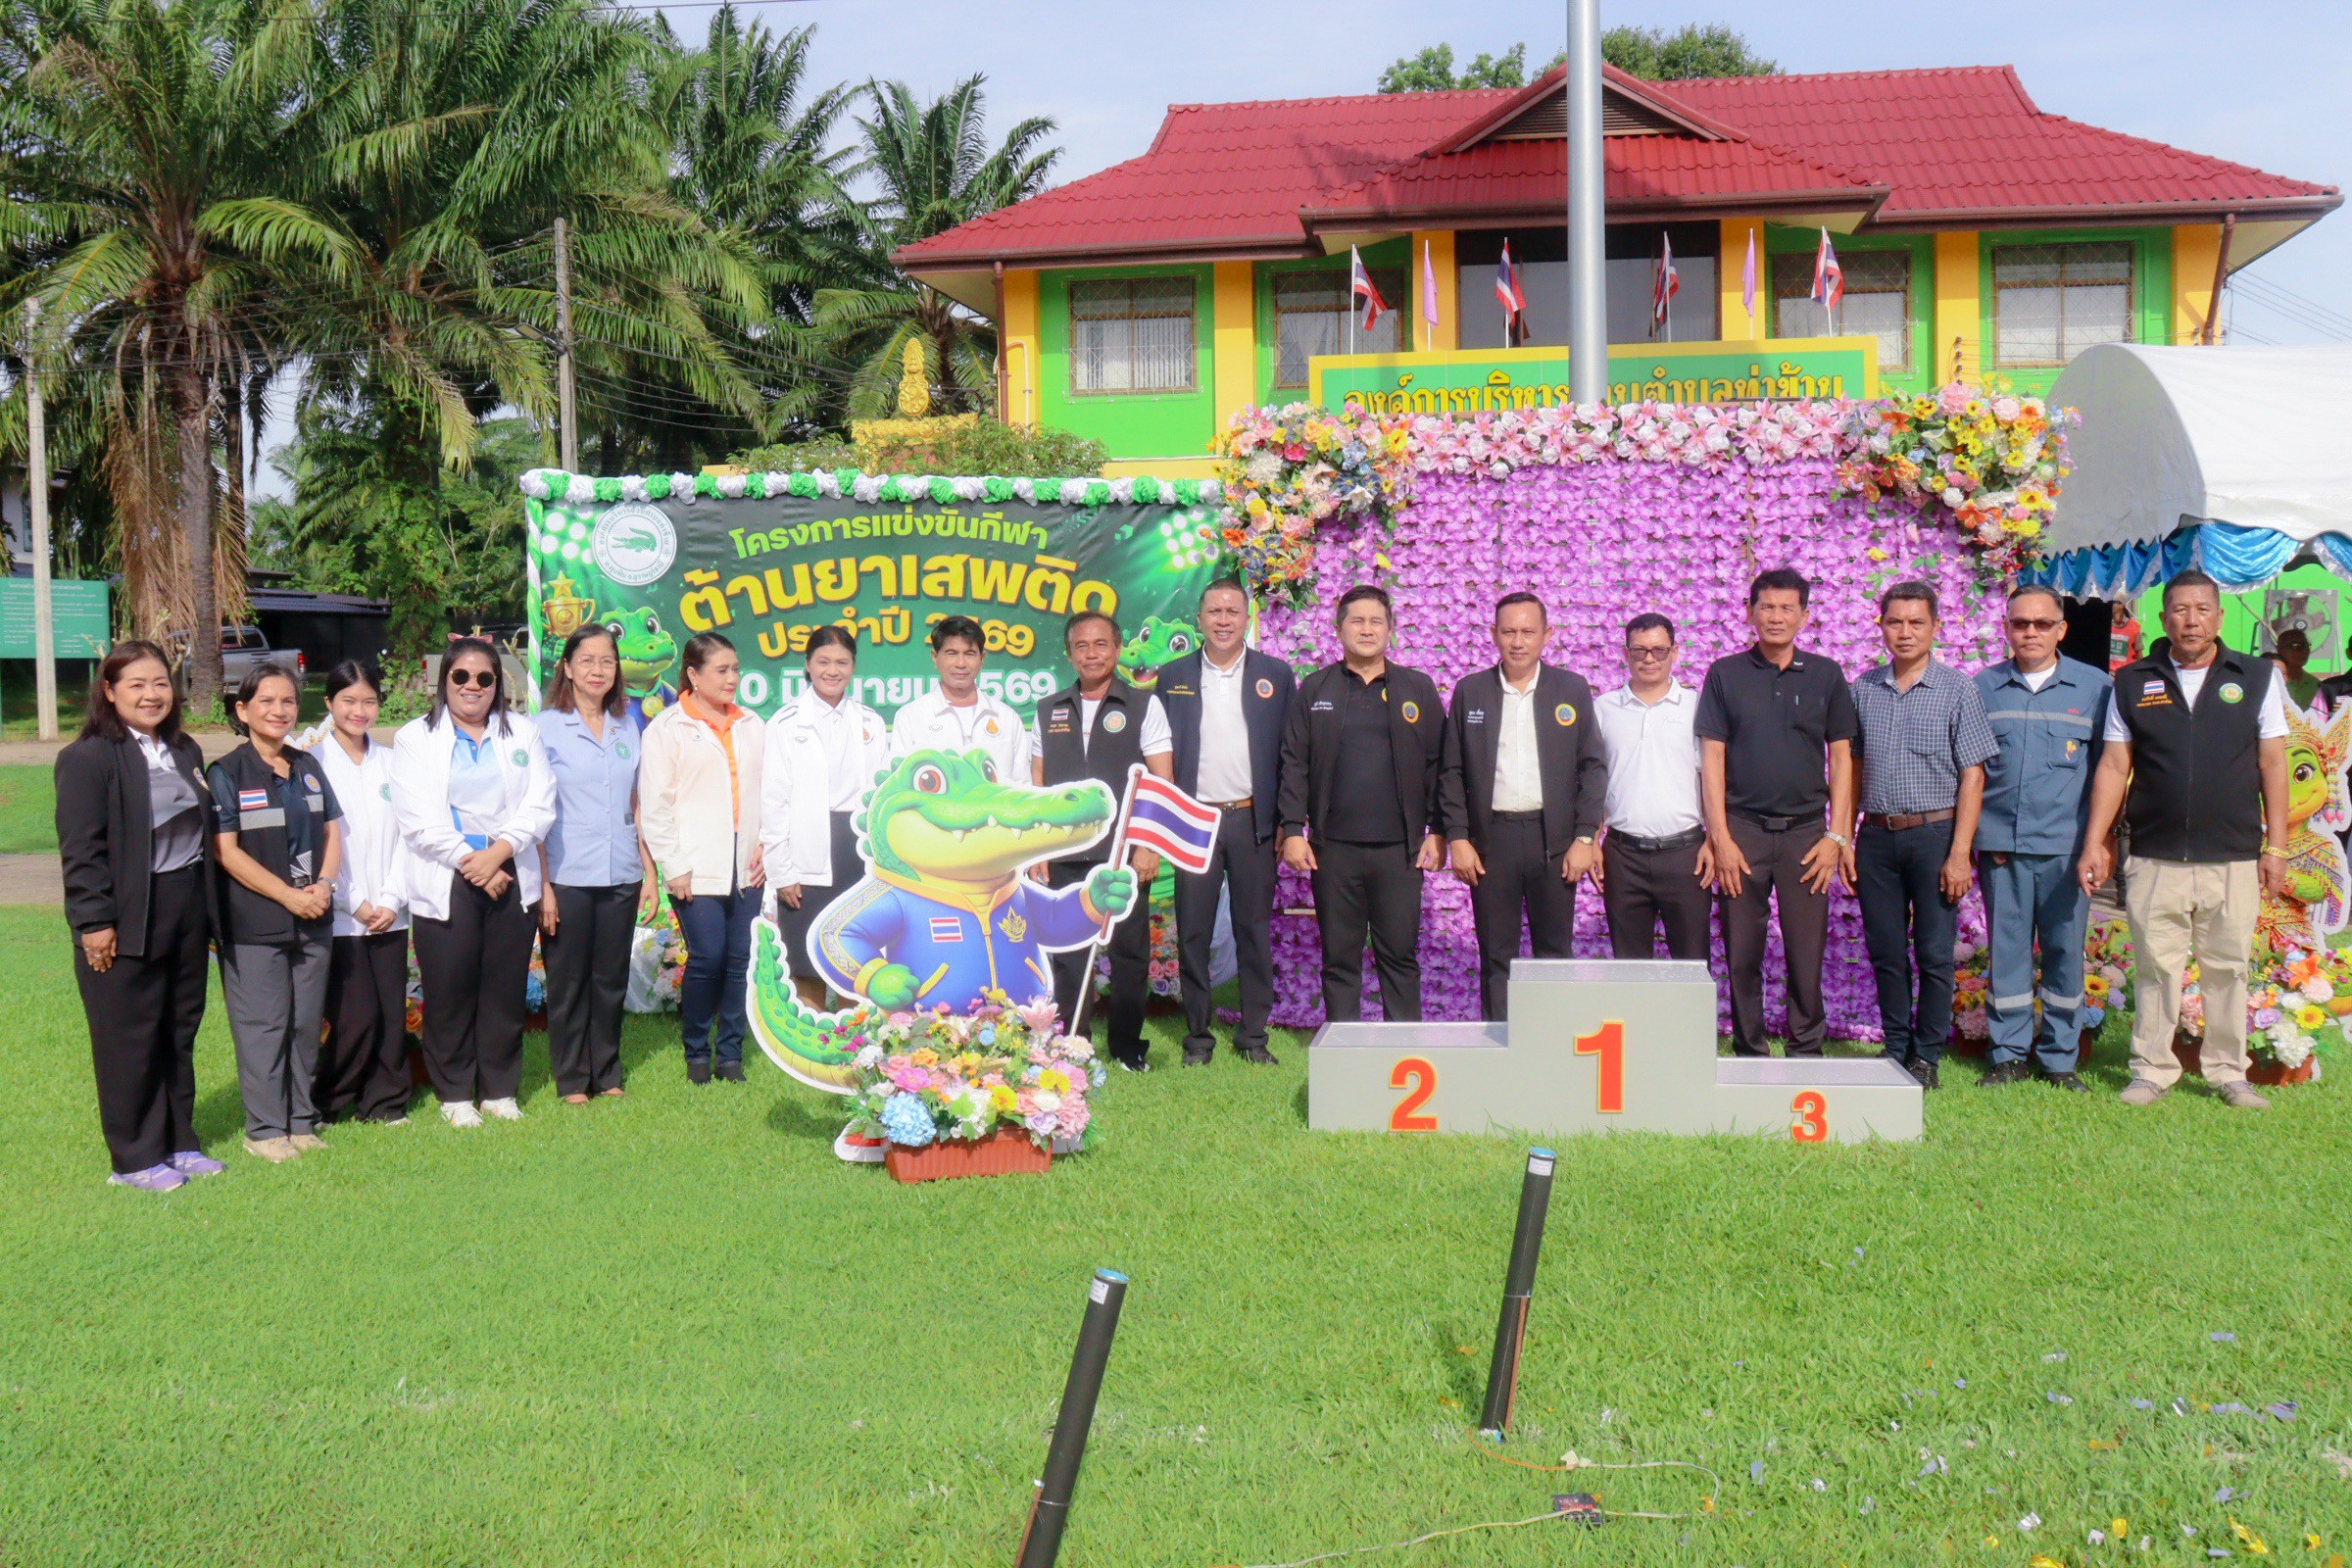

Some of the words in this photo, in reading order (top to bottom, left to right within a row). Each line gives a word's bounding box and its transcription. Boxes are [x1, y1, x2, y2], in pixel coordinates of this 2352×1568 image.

[728, 505, 1049, 559] โครงการแข่งขันกีฬา
[679, 554, 1117, 632] ต้านยาเสพติด
[758, 606, 910, 658] ปรจำปี
[924, 612, 1035, 657] 69
[782, 670, 940, 705] มิายน
[975, 671, 1056, 704] 569
[1574, 1020, 1625, 1113] 1
[1389, 1056, 1438, 1132] 2
[1791, 1090, 1829, 1144] 3
